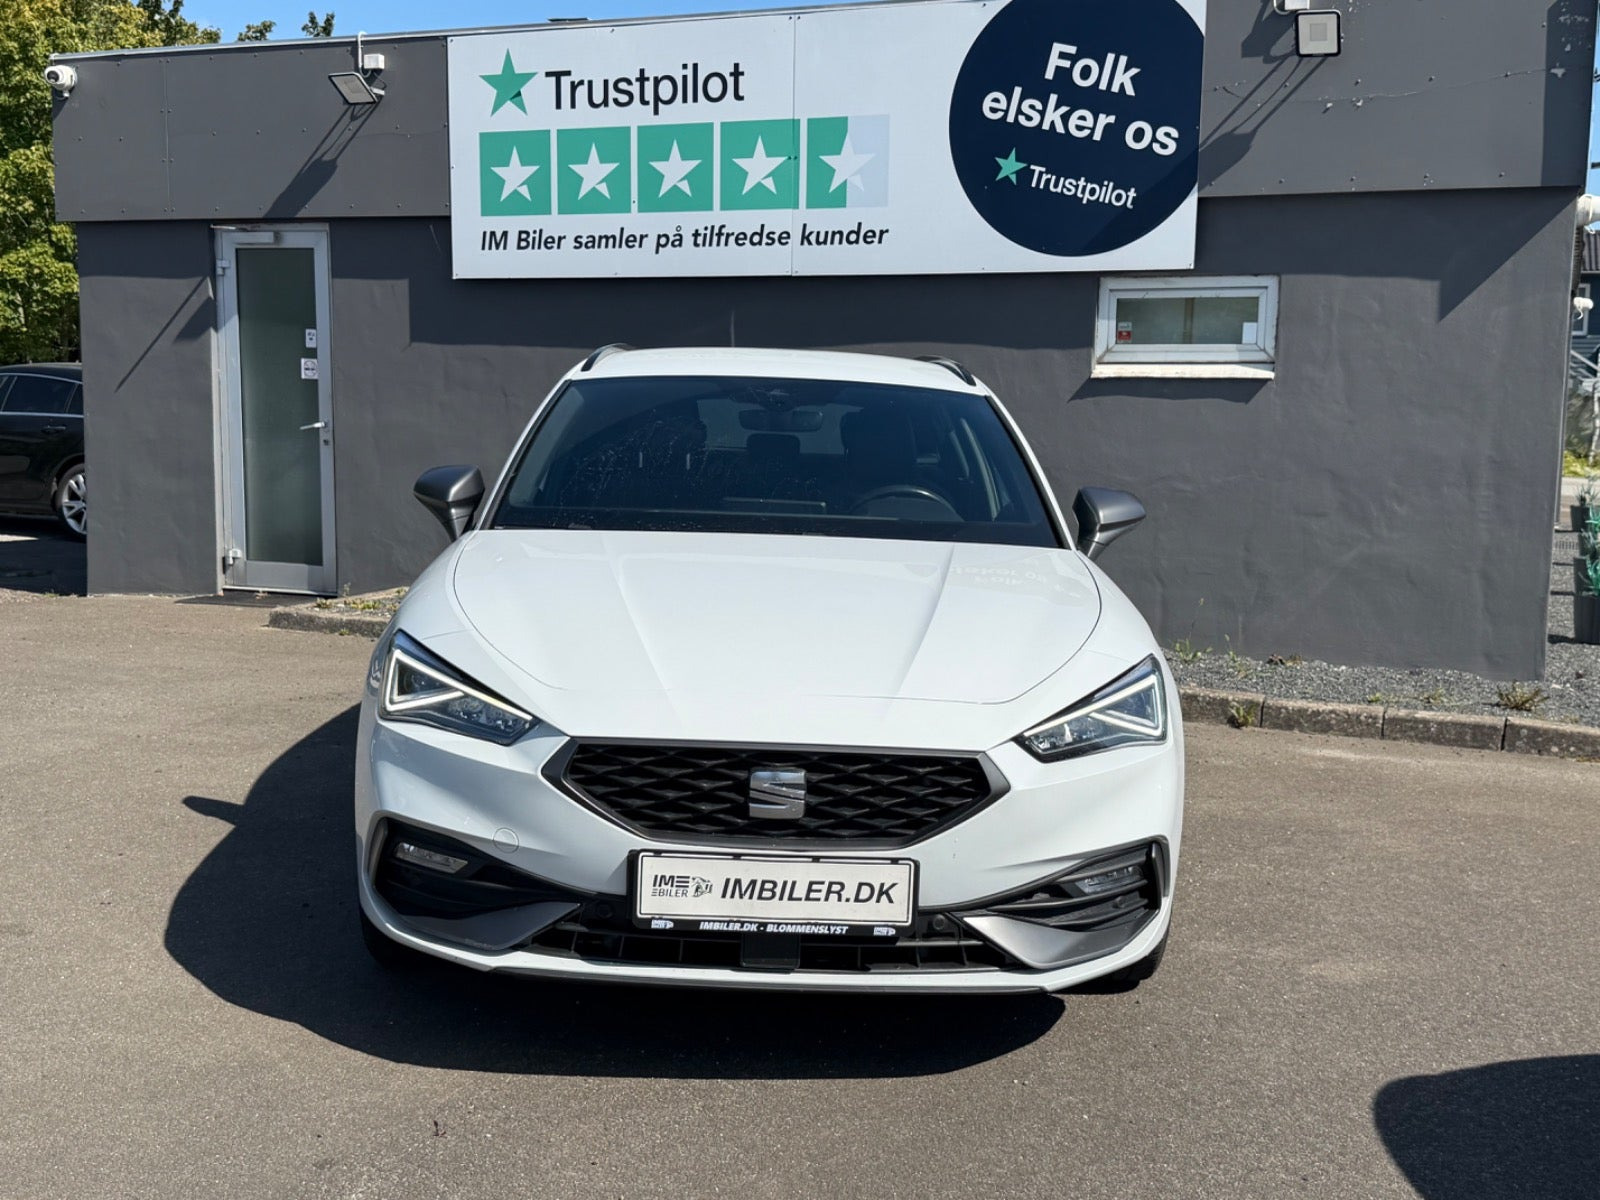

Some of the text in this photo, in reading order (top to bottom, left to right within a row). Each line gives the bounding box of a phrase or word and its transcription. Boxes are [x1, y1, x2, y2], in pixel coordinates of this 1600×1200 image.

[545, 62, 745, 116] Trustpilot
[1044, 42, 1141, 97] Folk
[982, 86, 1180, 157] elsker os
[1030, 164, 1137, 210] Trustpilot
[480, 221, 889, 254] IM Biler samler på tilfredse kunder
[721, 877, 898, 904] IMBILER.DK
[699, 921, 758, 932] IMBILER.DK
[766, 923, 849, 935] BLOMMENSLYST
